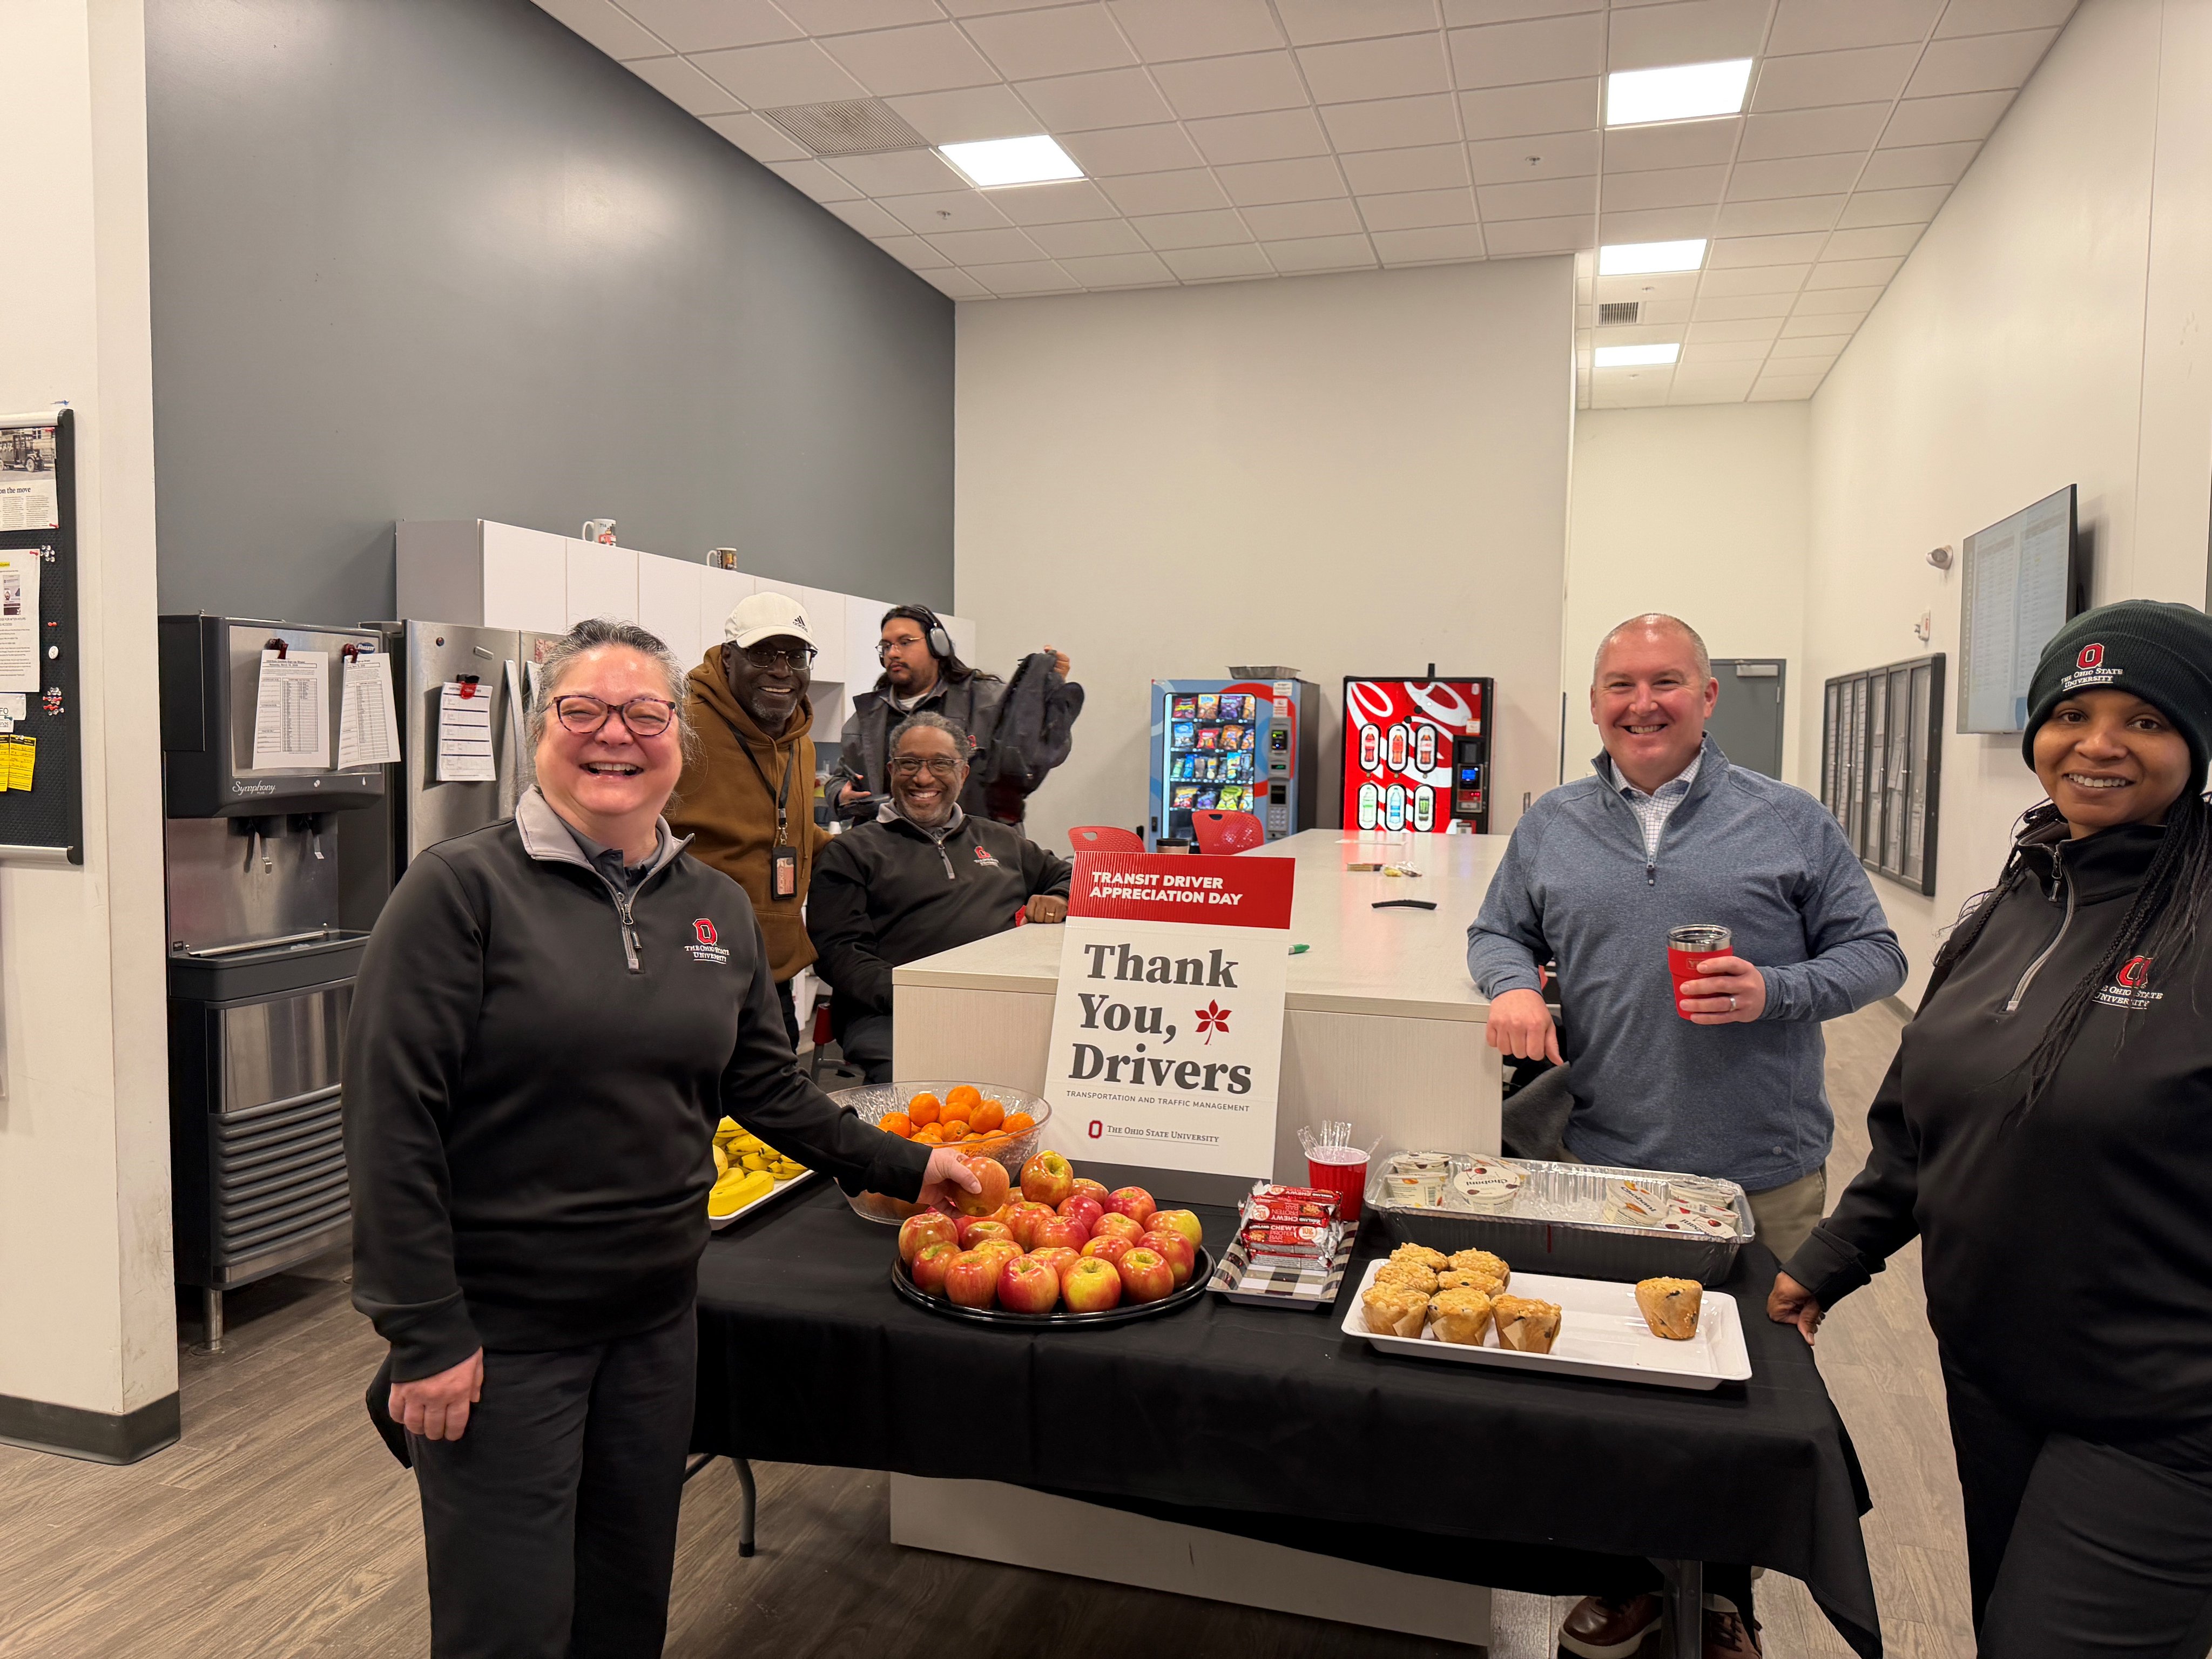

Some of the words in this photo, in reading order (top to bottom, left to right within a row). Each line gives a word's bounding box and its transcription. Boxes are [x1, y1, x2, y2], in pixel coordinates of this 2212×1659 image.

[2076, 642, 2105, 670] O
[2060, 675, 2072, 685] THE
[2073, 670, 2094, 678] OHIO
[2064, 676, 2114, 689] UNIVERSITY
[232, 780, 276, 796] Symphony
[1091, 871, 1160, 886] TRANSIT
[1163, 875, 1224, 889] DRIVER
[1089, 886, 1205, 904] APPRECIATION
[1208, 892, 1243, 906] DAY
[692, 918, 718, 946] O
[1084, 943, 1238, 988] Thank
[2109, 986, 2132, 996] OHIO
[1078, 993, 1177, 1044] You,
[1068, 1043, 1251, 1094] Drivers
[1067, 1090, 1136, 1102] TRANSPORTATION
[1158, 1098, 1191, 1107] TRAFFIC
[1193, 1101, 1250, 1112] MANAGEMENT
[1107, 1125, 1123, 1134] THE
[1124, 1127, 1144, 1136] OHIO
[1145, 1129, 1170, 1138] STATE
[1171, 1131, 1220, 1143] UNIVERSITY
[1466, 1178, 1508, 1186] Chobani
[1621, 1186, 1657, 1212] Chobani
[1302, 1228, 1314, 1236] 10g
